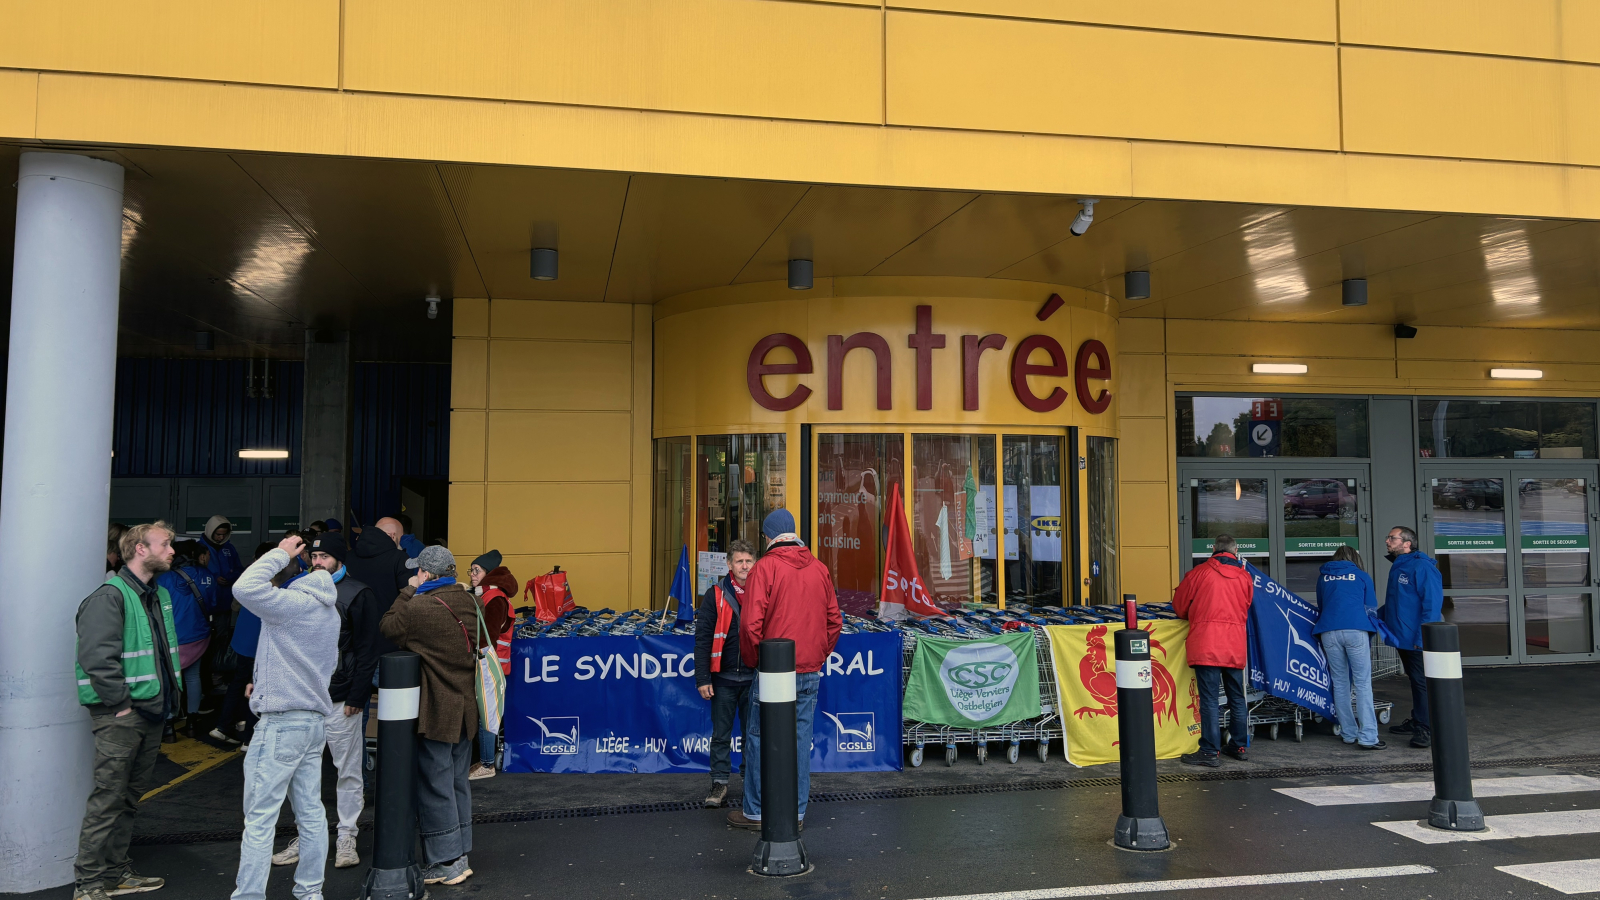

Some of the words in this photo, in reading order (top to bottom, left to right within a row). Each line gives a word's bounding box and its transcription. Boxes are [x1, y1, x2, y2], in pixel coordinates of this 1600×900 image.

[746, 293, 1112, 415] entrée
[818, 491, 868, 504] ommence
[818, 513, 836, 525] ans
[823, 533, 861, 550] cuisine
[524, 655, 560, 683] LE
[573, 653, 695, 681] SYNDIC
[954, 663, 1008, 687] CSC
[1289, 659, 1330, 688] CGSLB
[1273, 677, 1291, 693] HUY
[950, 688, 973, 701] Liège
[975, 686, 1010, 698] Verviers
[957, 699, 1003, 712] Ostbelgien
[543, 744, 577, 753] CGSLB
[595, 731, 630, 753] LIÈGE
[644, 737, 668, 753] HUY
[839, 741, 873, 750] CGSLB
